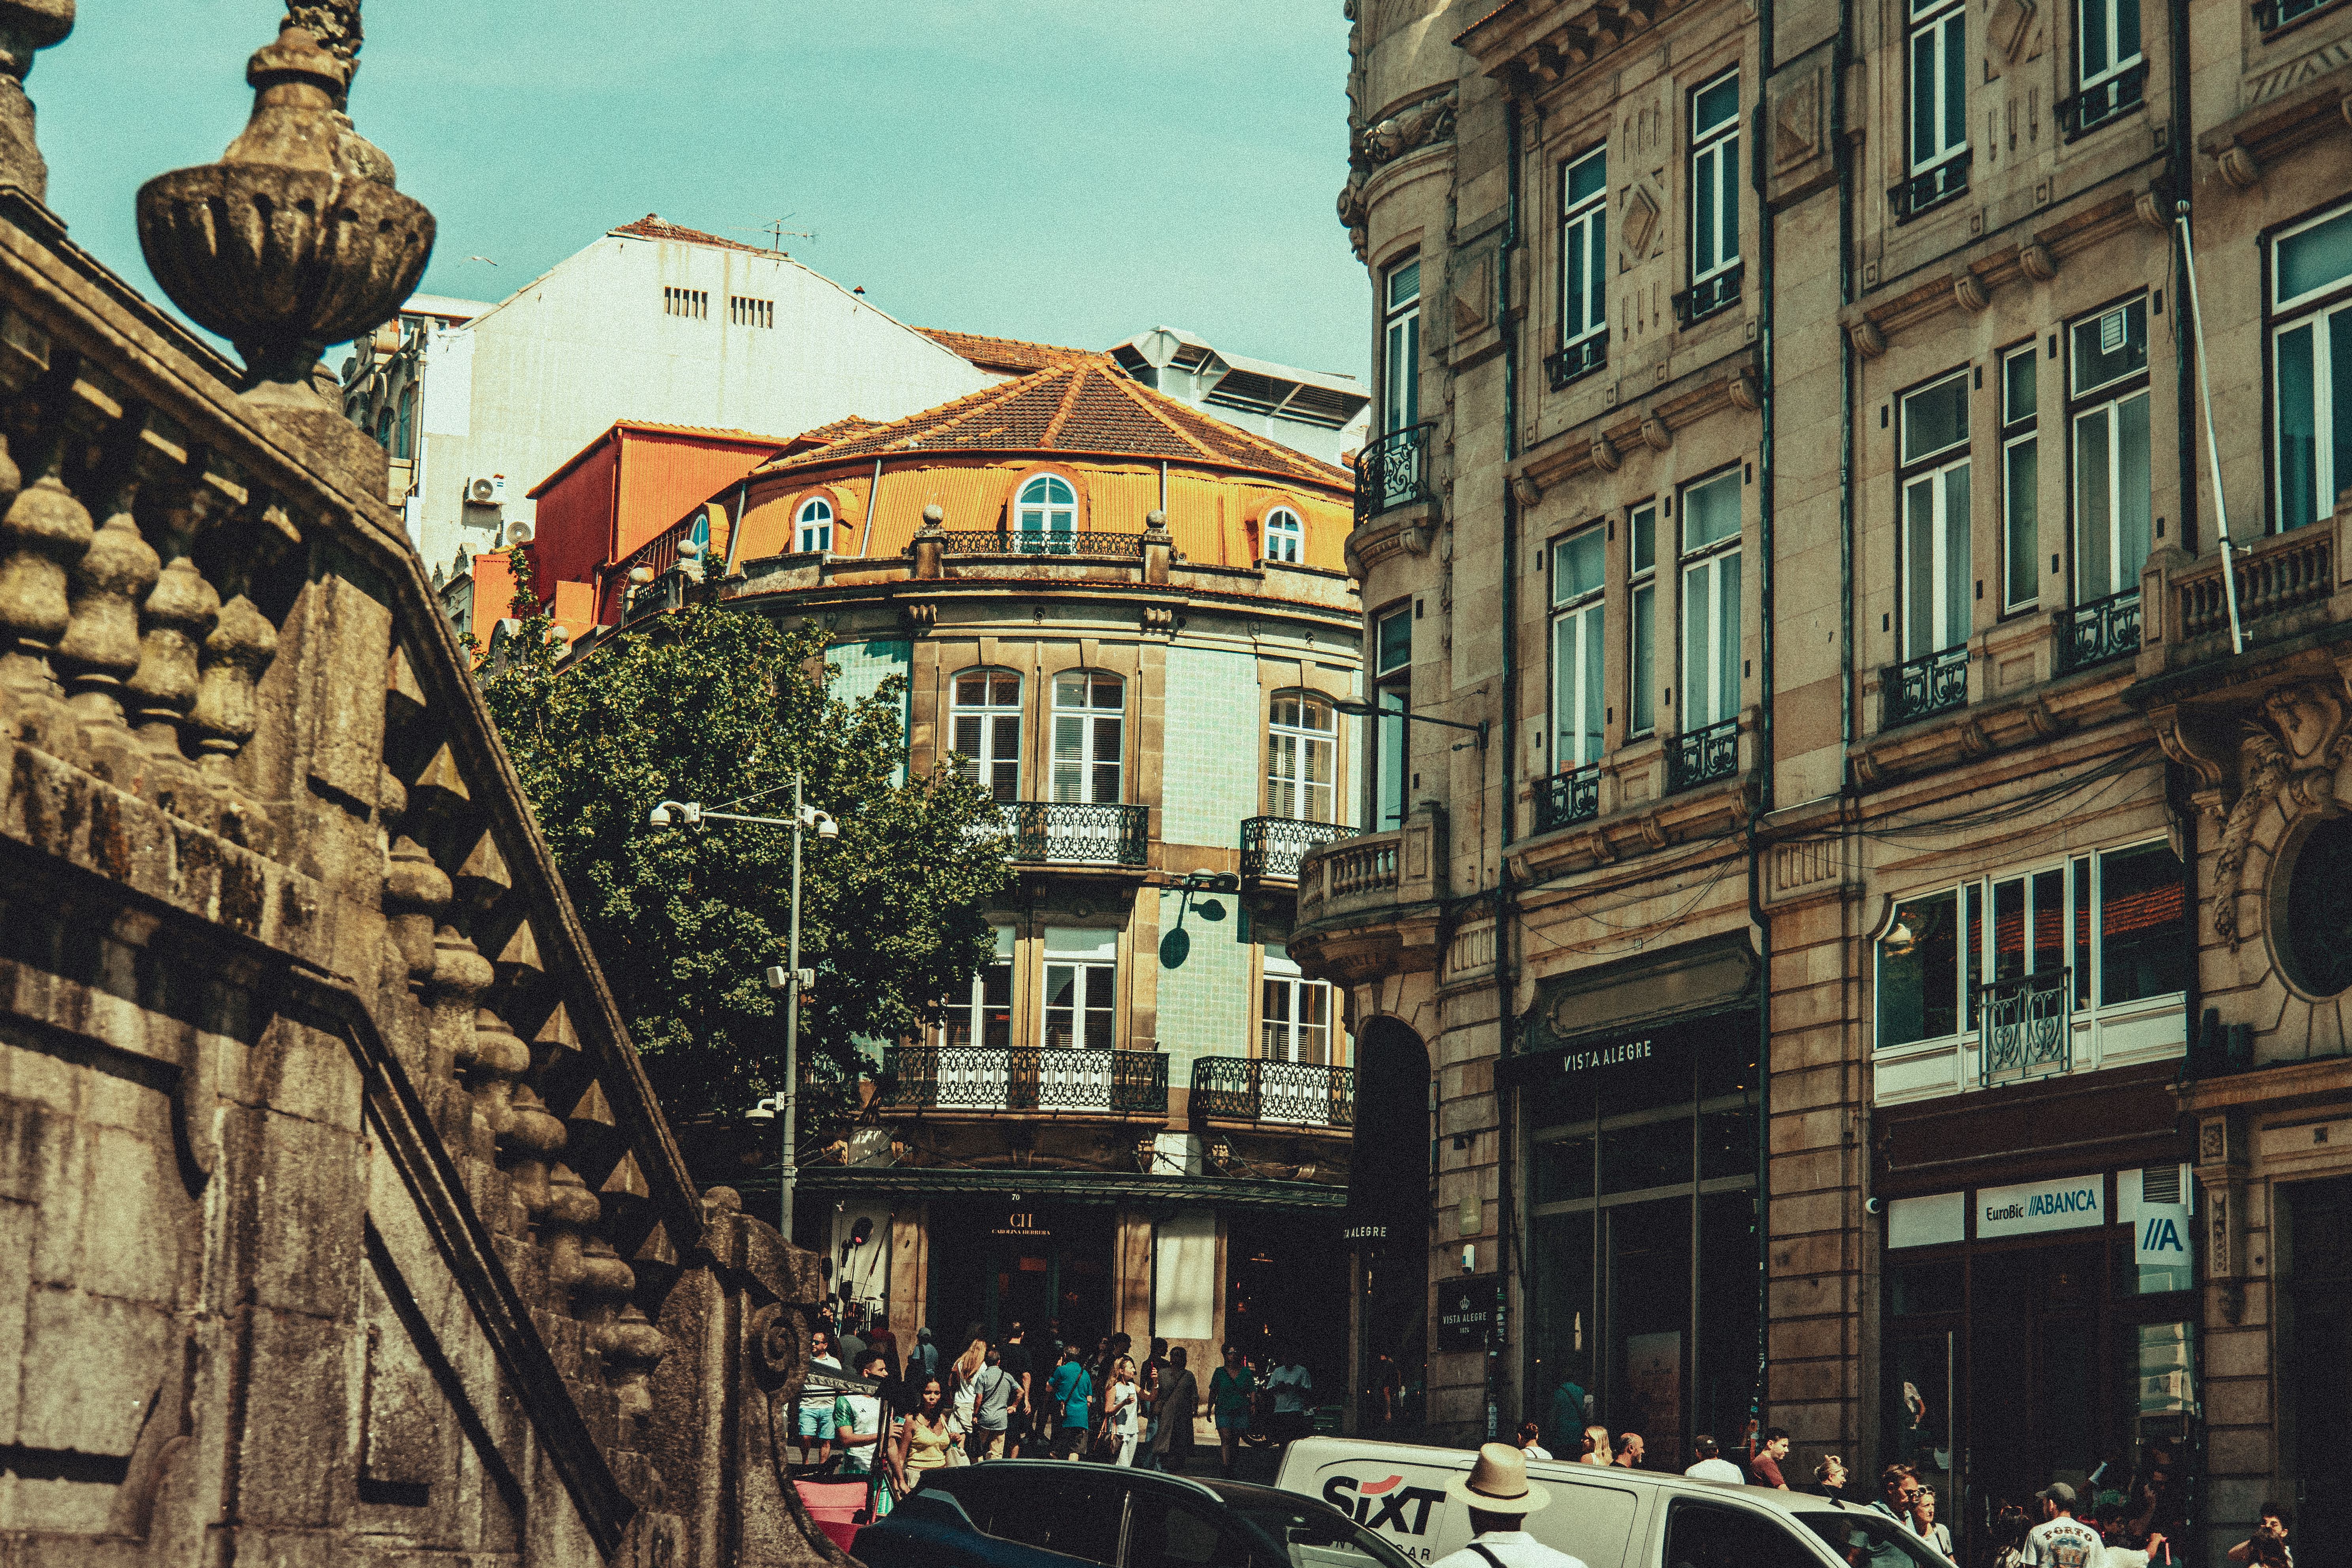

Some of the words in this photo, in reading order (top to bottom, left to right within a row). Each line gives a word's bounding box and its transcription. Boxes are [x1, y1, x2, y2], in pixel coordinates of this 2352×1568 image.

[1564, 1051, 1599, 1072] VISTA
[1603, 1040, 1651, 1065] ALEGRE
[1986, 1204, 2024, 1221] EuroBic
[1351, 1226, 1386, 1237] ALEGRE
[1443, 1315, 1460, 1324] VISTA
[1463, 1312, 1486, 1322] ALEGRE
[2043, 1526, 2093, 1542] PORTO
